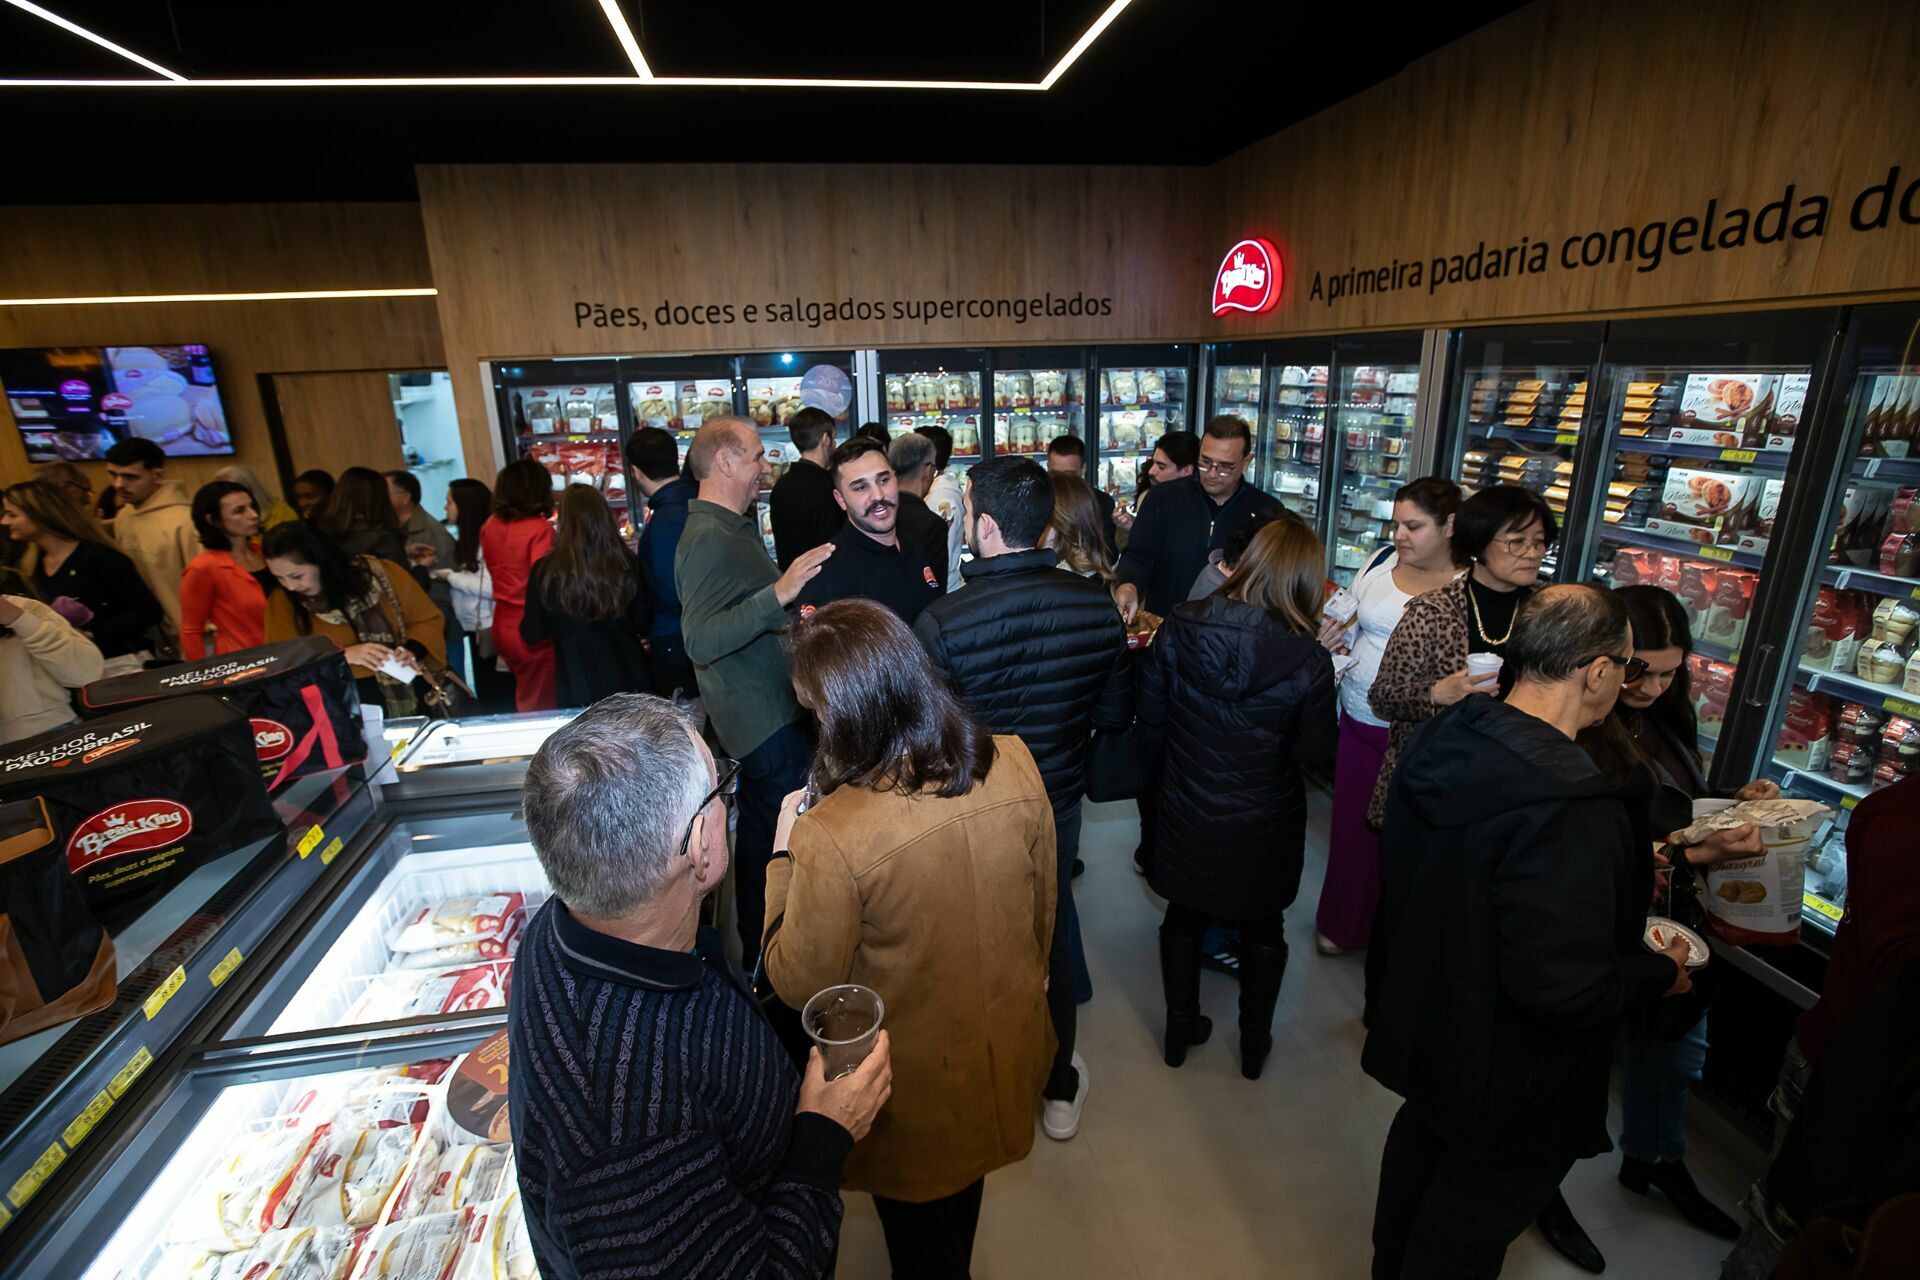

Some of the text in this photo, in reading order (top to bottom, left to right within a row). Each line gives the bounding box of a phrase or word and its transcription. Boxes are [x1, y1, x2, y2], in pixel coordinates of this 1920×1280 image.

[1309, 271, 1323, 302] A
[1327, 259, 1424, 307] primeira
[1429, 236, 1550, 295] padaria
[1560, 184, 1830, 273] congelada
[574, 292, 1112, 330] Pães, doces e salgados supercongelados
[0, 732, 97, 766] MELHOR
[75, 810, 183, 857] Bread King
